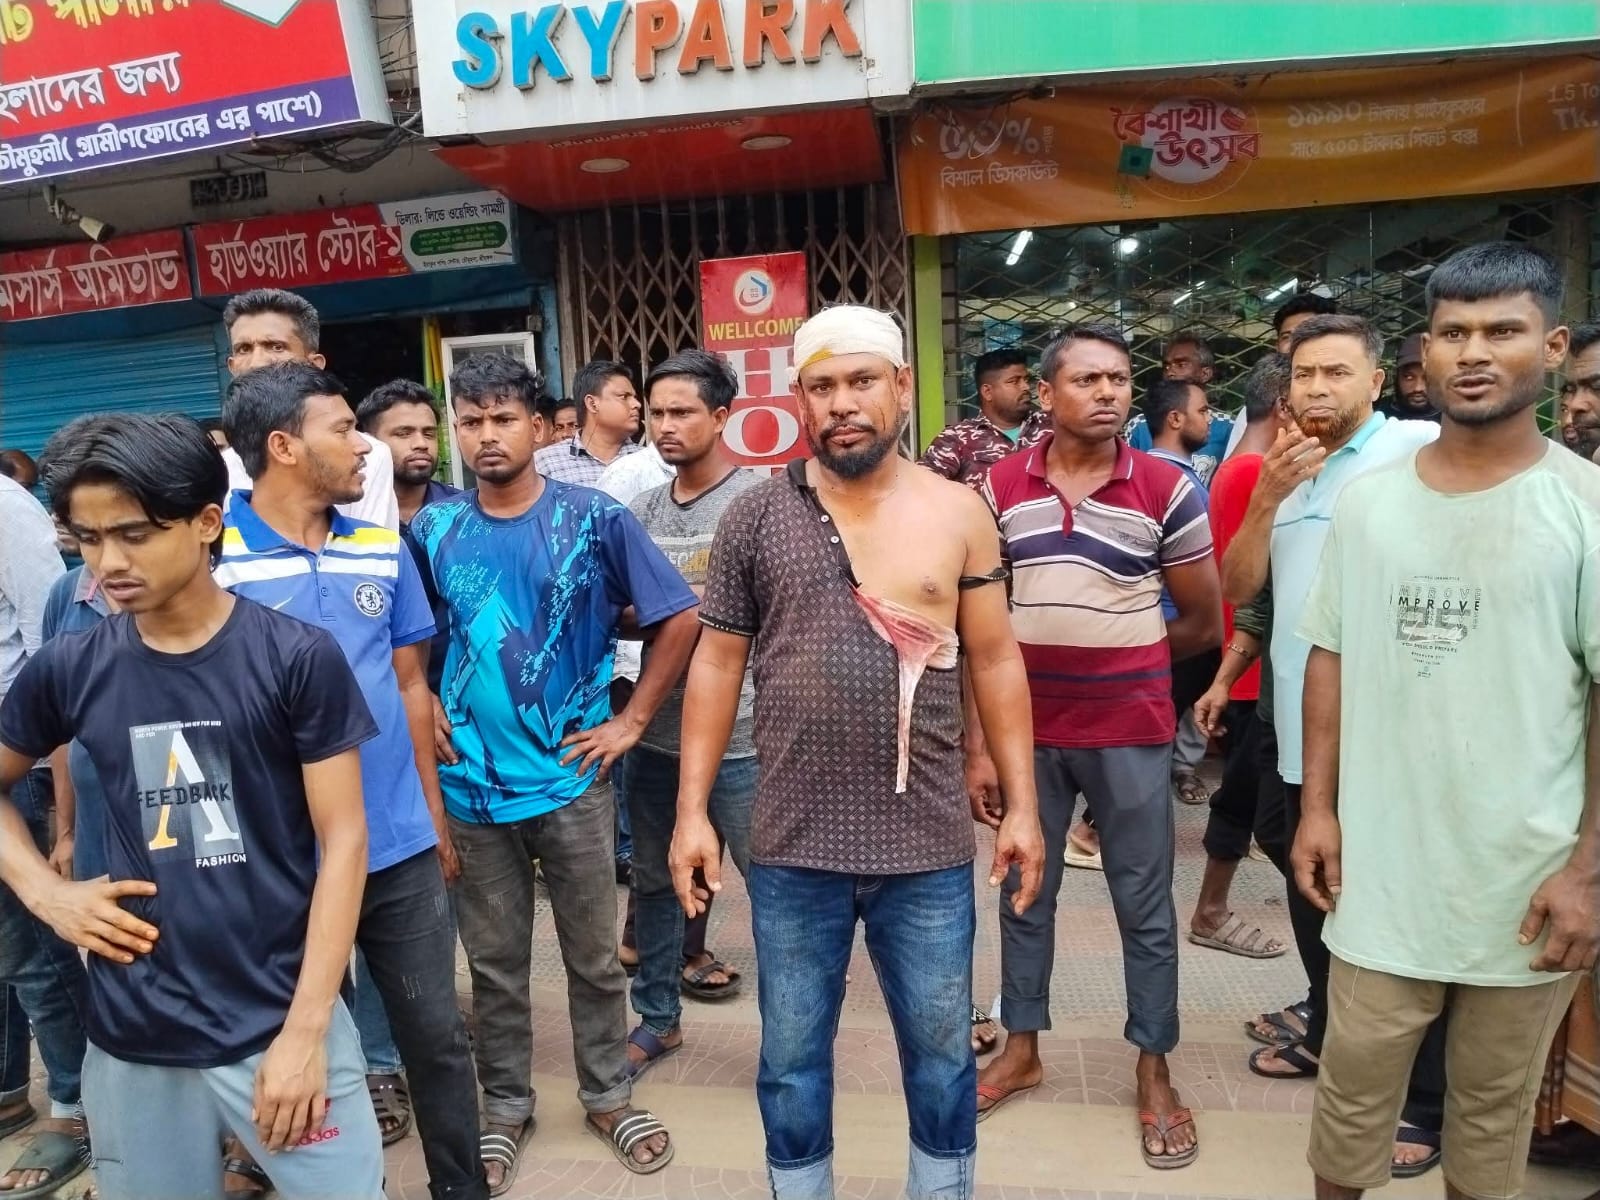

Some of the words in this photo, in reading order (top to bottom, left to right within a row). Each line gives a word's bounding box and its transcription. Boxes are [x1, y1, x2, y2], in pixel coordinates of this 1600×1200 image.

[108, 51, 182, 97] জন্য
[77, 112, 210, 158] গ্রামীণফোনের
[216, 104, 251, 132] এর
[1109, 99, 1218, 140] বৈশাখী
[1287, 101, 1362, 127] ১৯৯০
[1154, 130, 1264, 169] উৎসব
[940, 165, 984, 190] বিশাল
[986, 159, 1059, 185] ডিসকাউন্ট
[67, 242, 179, 302] অমিতাভ
[136, 782, 232, 808] FEEDBACK
[195, 853, 247, 869] FASHION
